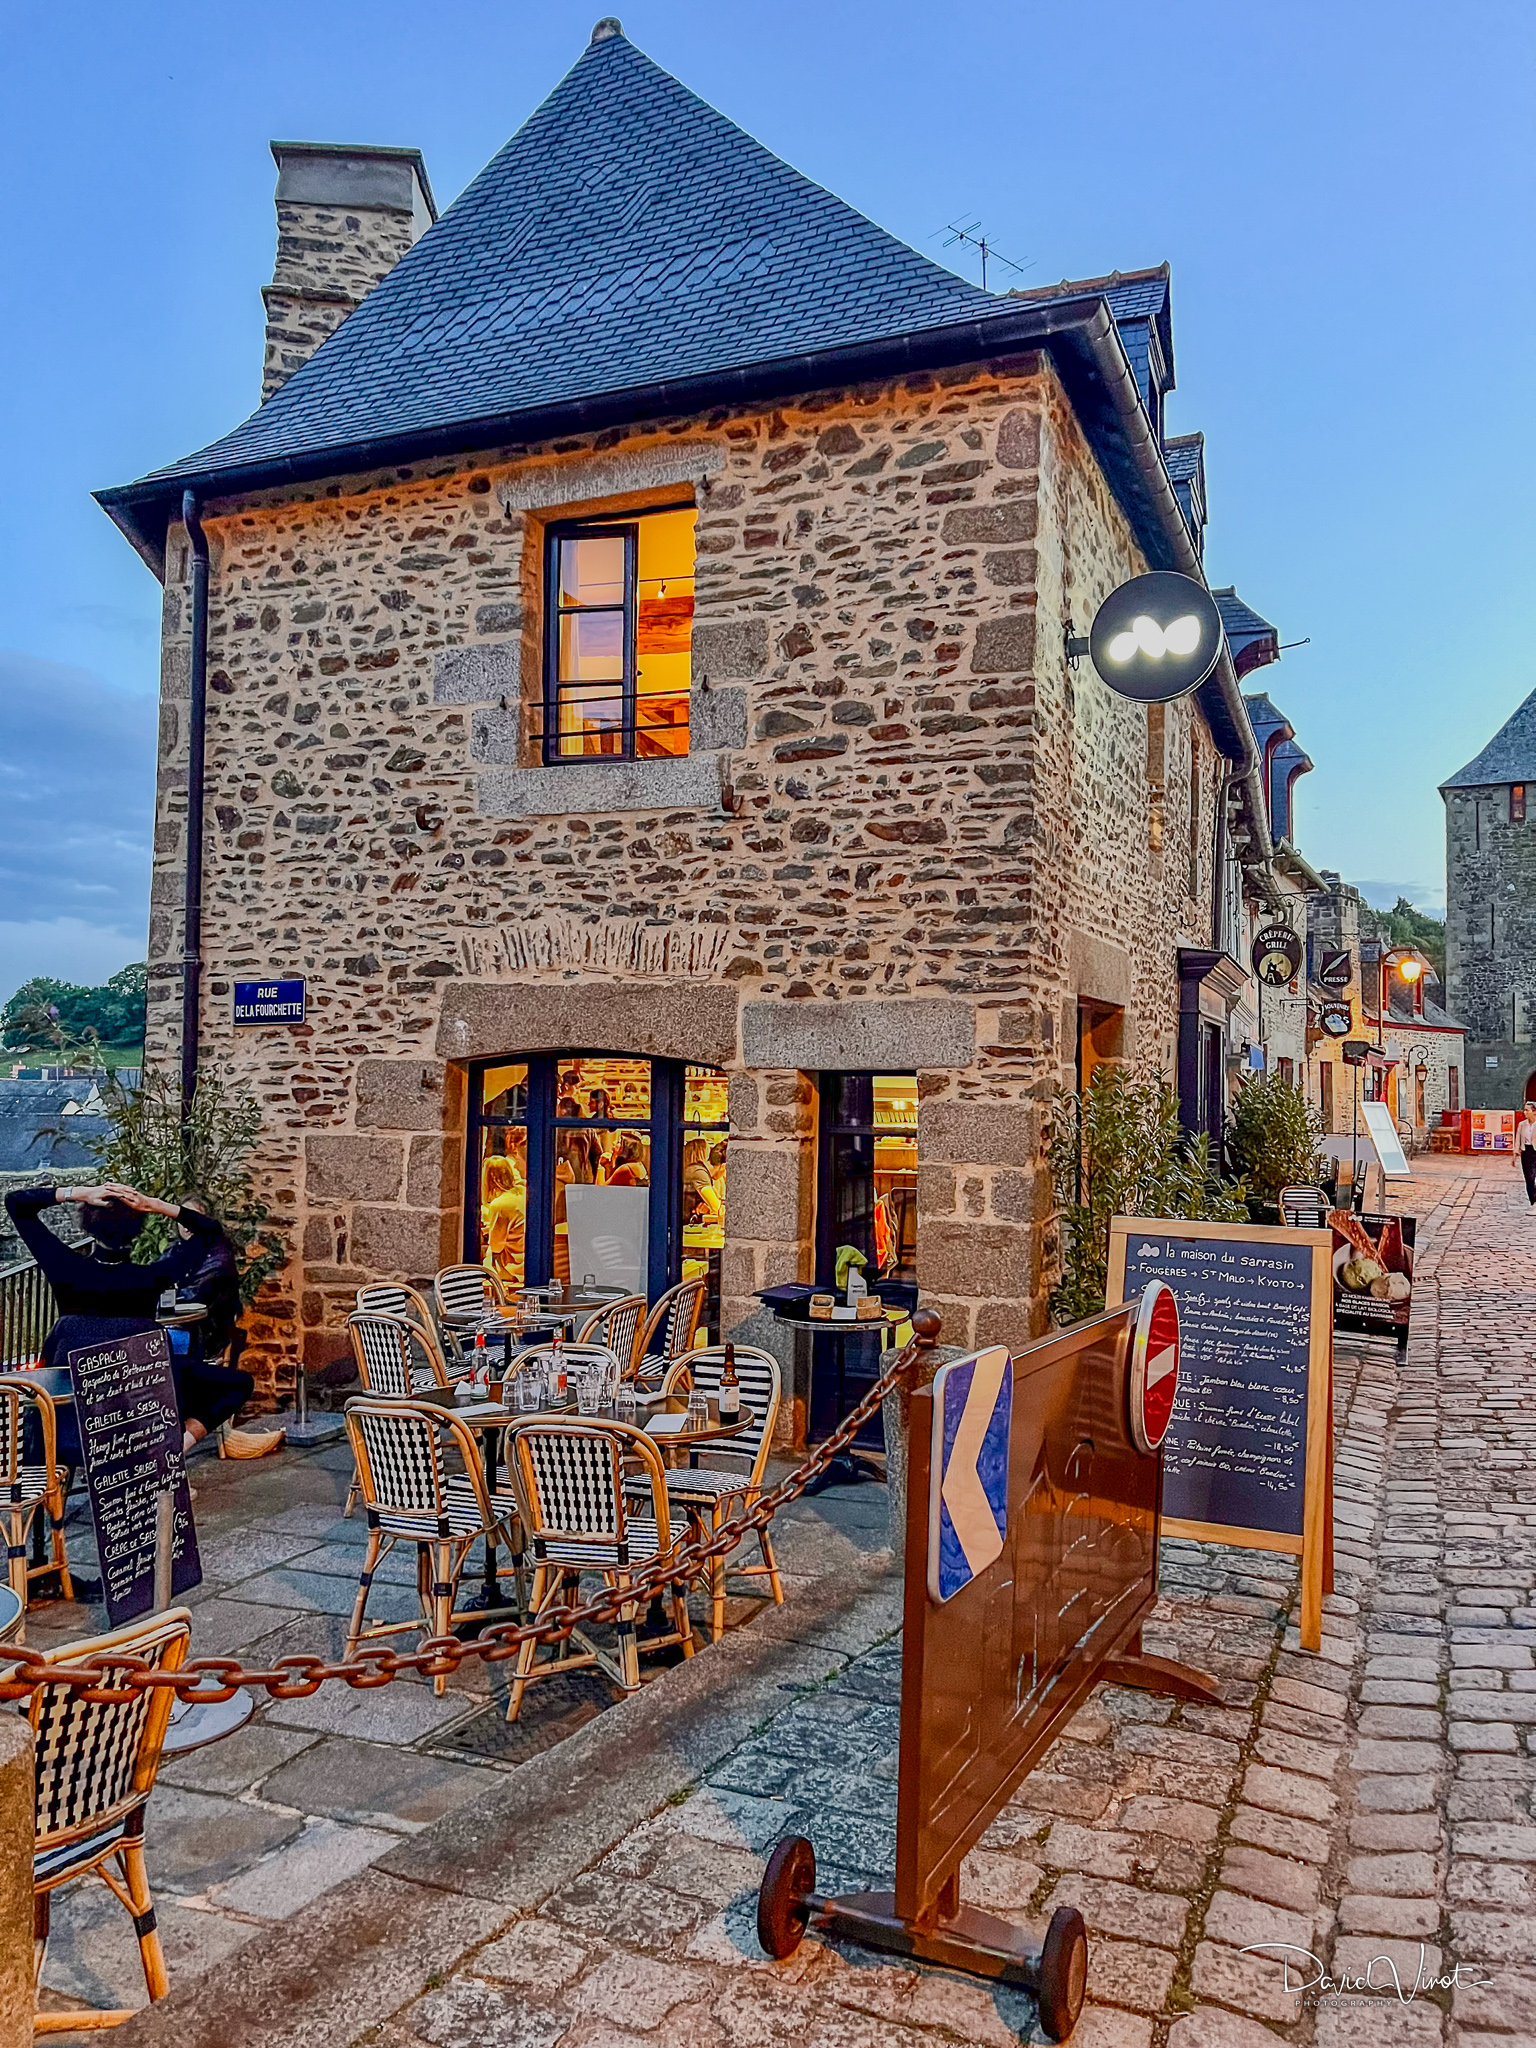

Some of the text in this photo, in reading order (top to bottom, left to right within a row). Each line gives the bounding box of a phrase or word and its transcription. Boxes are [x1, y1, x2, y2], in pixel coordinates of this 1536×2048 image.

[1259, 930, 1296, 942] CRÊPERIE
[1265, 941, 1288, 950] GRILL
[257, 988, 278, 998] RUE
[236, 1003, 302, 1017] DE LA FOURCHETTE
[1165, 1242, 1294, 1270] la maison du sarrasin
[1218, 1272, 1246, 1284] MALO
[1257, 1275, 1295, 1290] KYOTO
[77, 1350, 127, 1373] GASPACHO
[1200, 1374, 1228, 1386] Jambon
[1230, 1378, 1245, 1388] bleu
[1248, 1381, 1270, 1392] blanc
[85, 1410, 125, 1431] GALETTE
[94, 1469, 130, 1490] GALETTE
